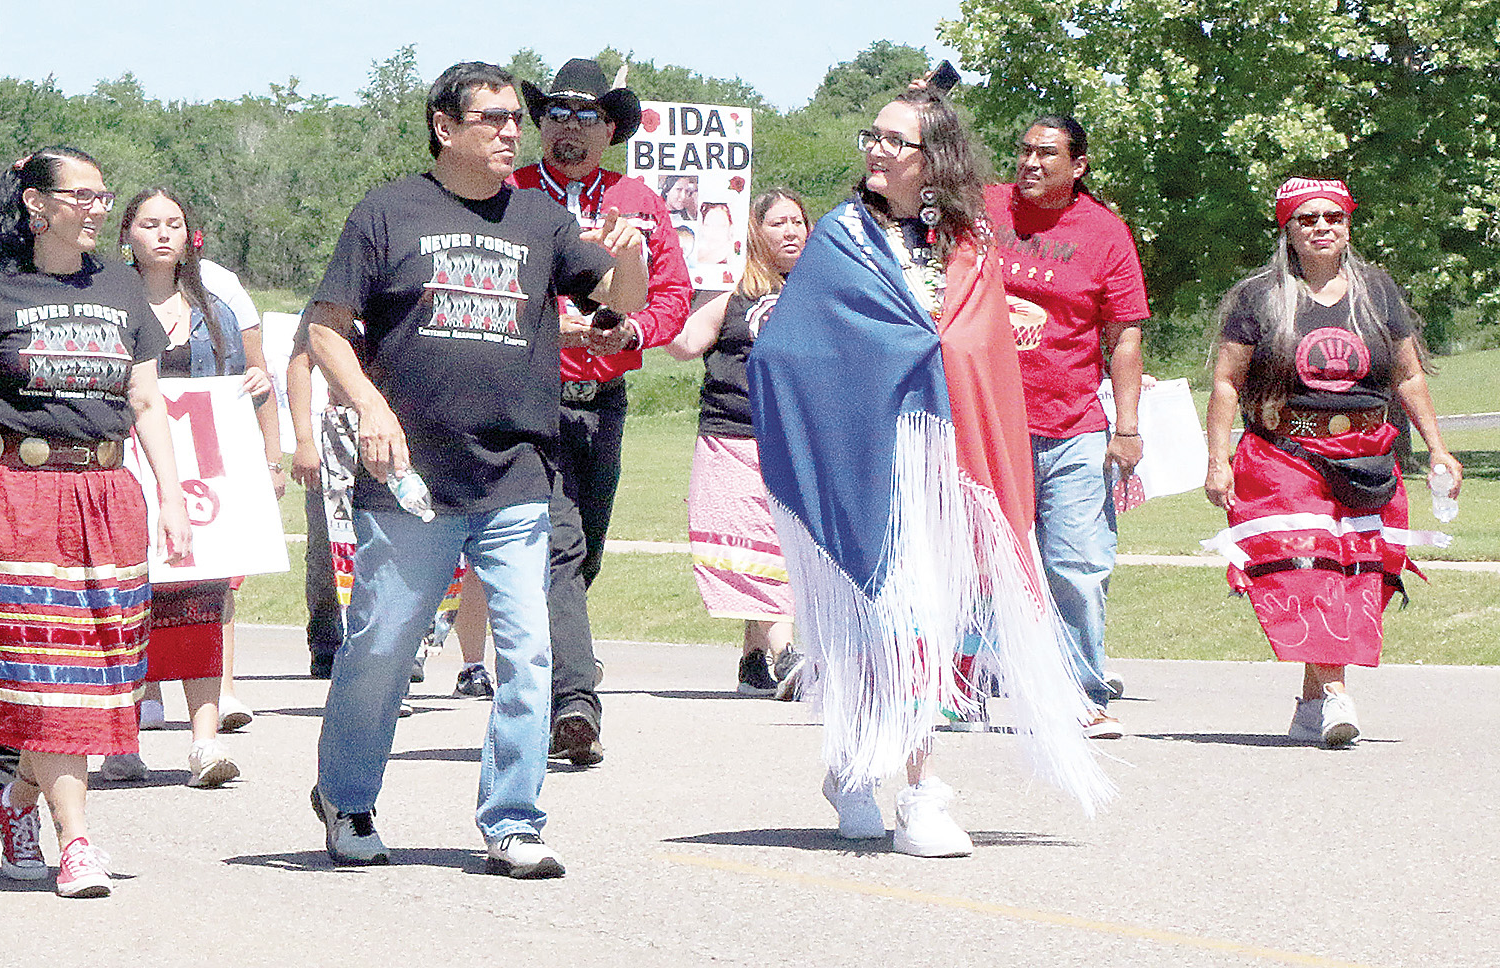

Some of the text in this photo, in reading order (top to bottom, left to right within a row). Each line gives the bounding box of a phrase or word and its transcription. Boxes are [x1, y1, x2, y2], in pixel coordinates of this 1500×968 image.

[668, 107, 727, 137] IDA
[634, 141, 750, 171] BEARD
[419, 233, 529, 265] NEVER FORGET
[16, 303, 129, 329] NEVER FORGET
